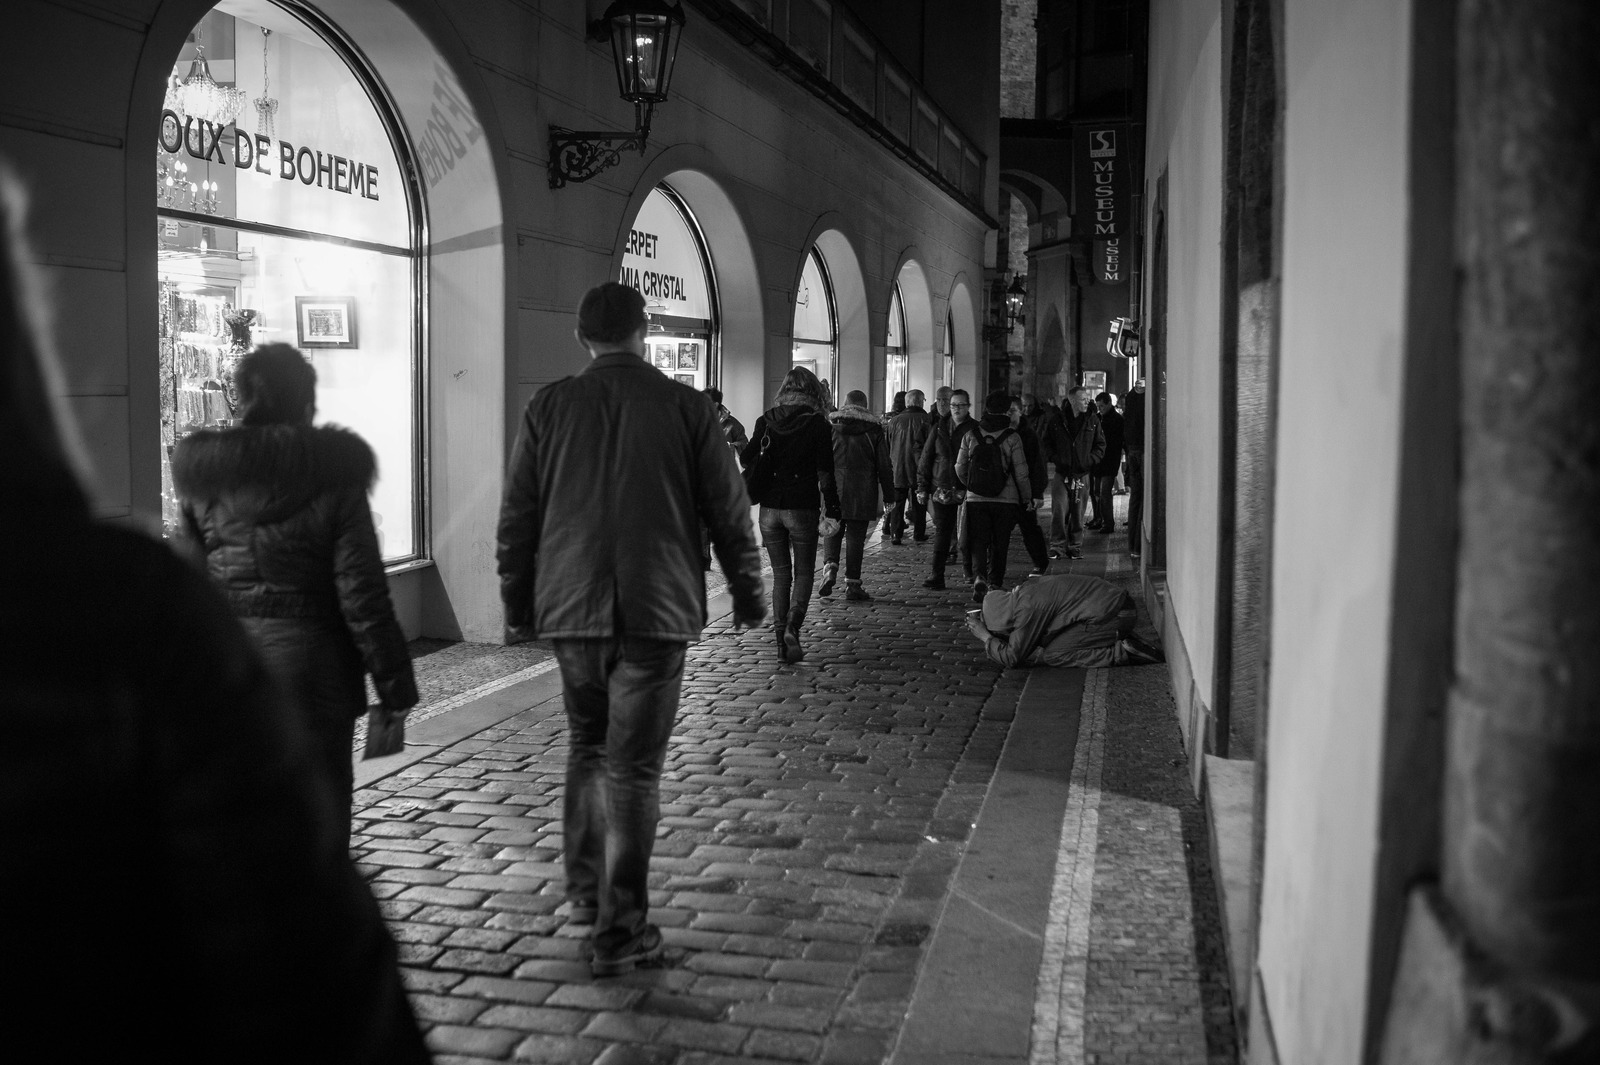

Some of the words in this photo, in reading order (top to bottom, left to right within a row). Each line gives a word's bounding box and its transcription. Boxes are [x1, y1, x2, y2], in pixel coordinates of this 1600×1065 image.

[234, 127, 271, 175] DE
[279, 140, 379, 201] BOHEME
[1093, 160, 1116, 235] MUSEUM
[643, 271, 687, 301] CRYSTAL
